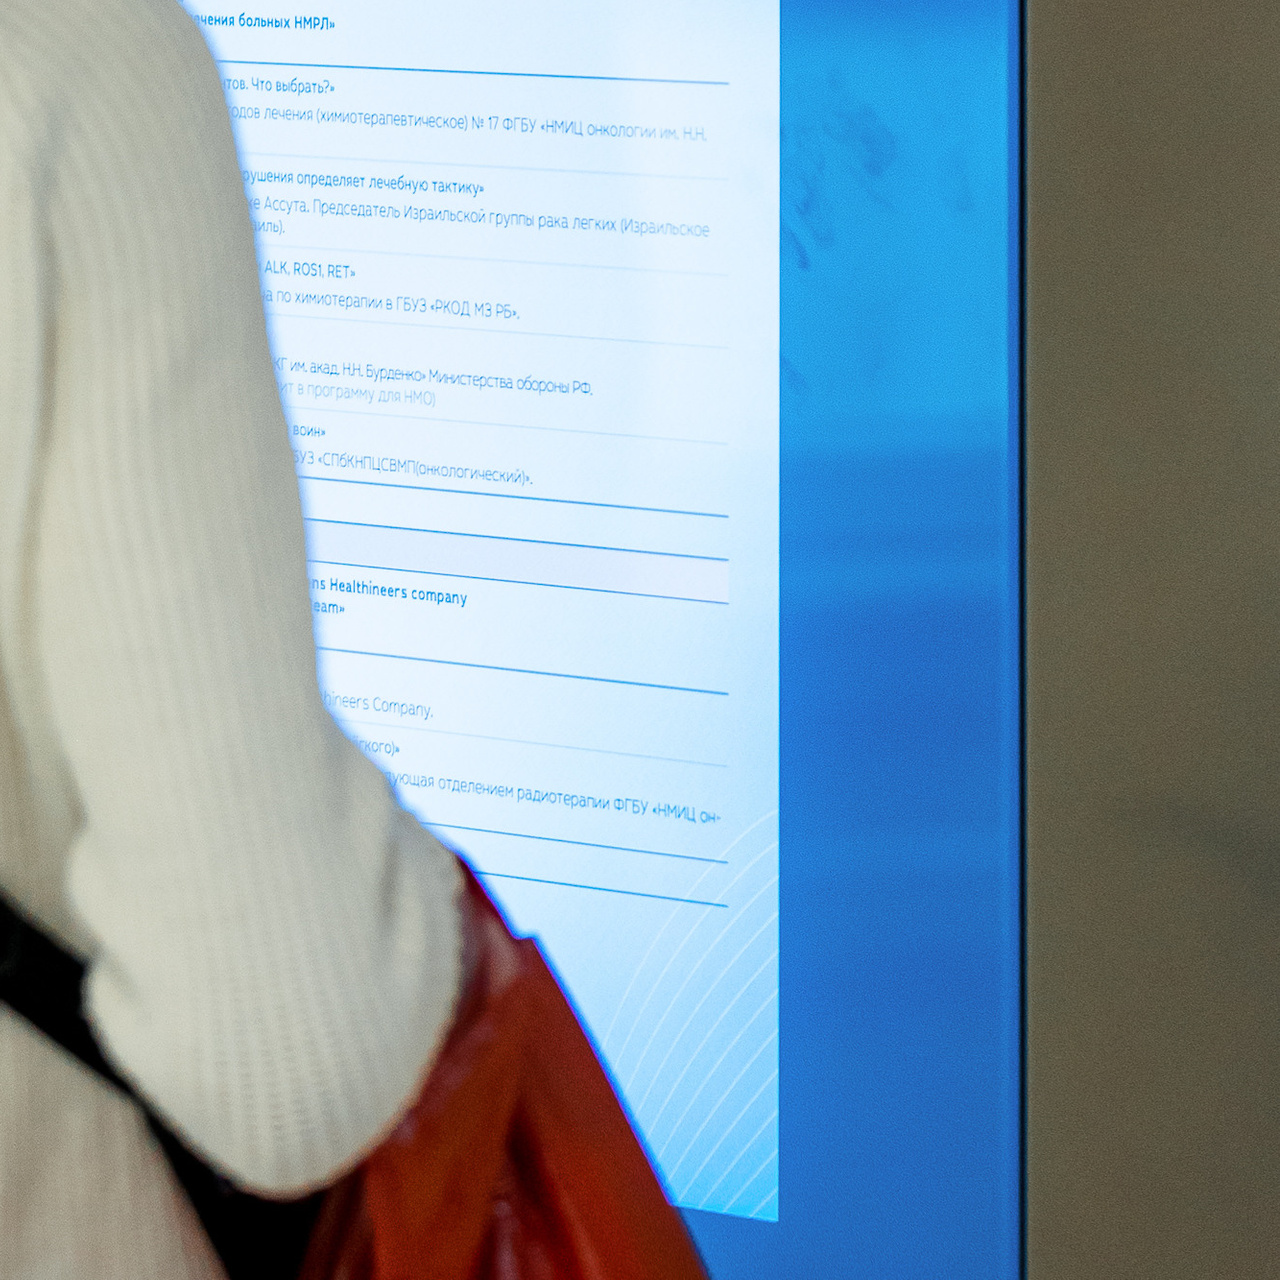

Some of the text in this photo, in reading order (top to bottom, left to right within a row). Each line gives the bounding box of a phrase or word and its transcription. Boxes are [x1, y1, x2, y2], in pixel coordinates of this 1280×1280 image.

[238, 12, 291, 29] больных
[250, 76, 273, 92] Что
[296, 173, 366, 188] определяет
[368, 175, 429, 194] лечебную
[329, 578, 408, 598] Healthineers
[411, 589, 468, 608] company
[437, 777, 514, 797] отделением
[516, 788, 610, 809] радиотерапии
[613, 797, 649, 815] ФГБУ
[699, 810, 721, 824] он-
